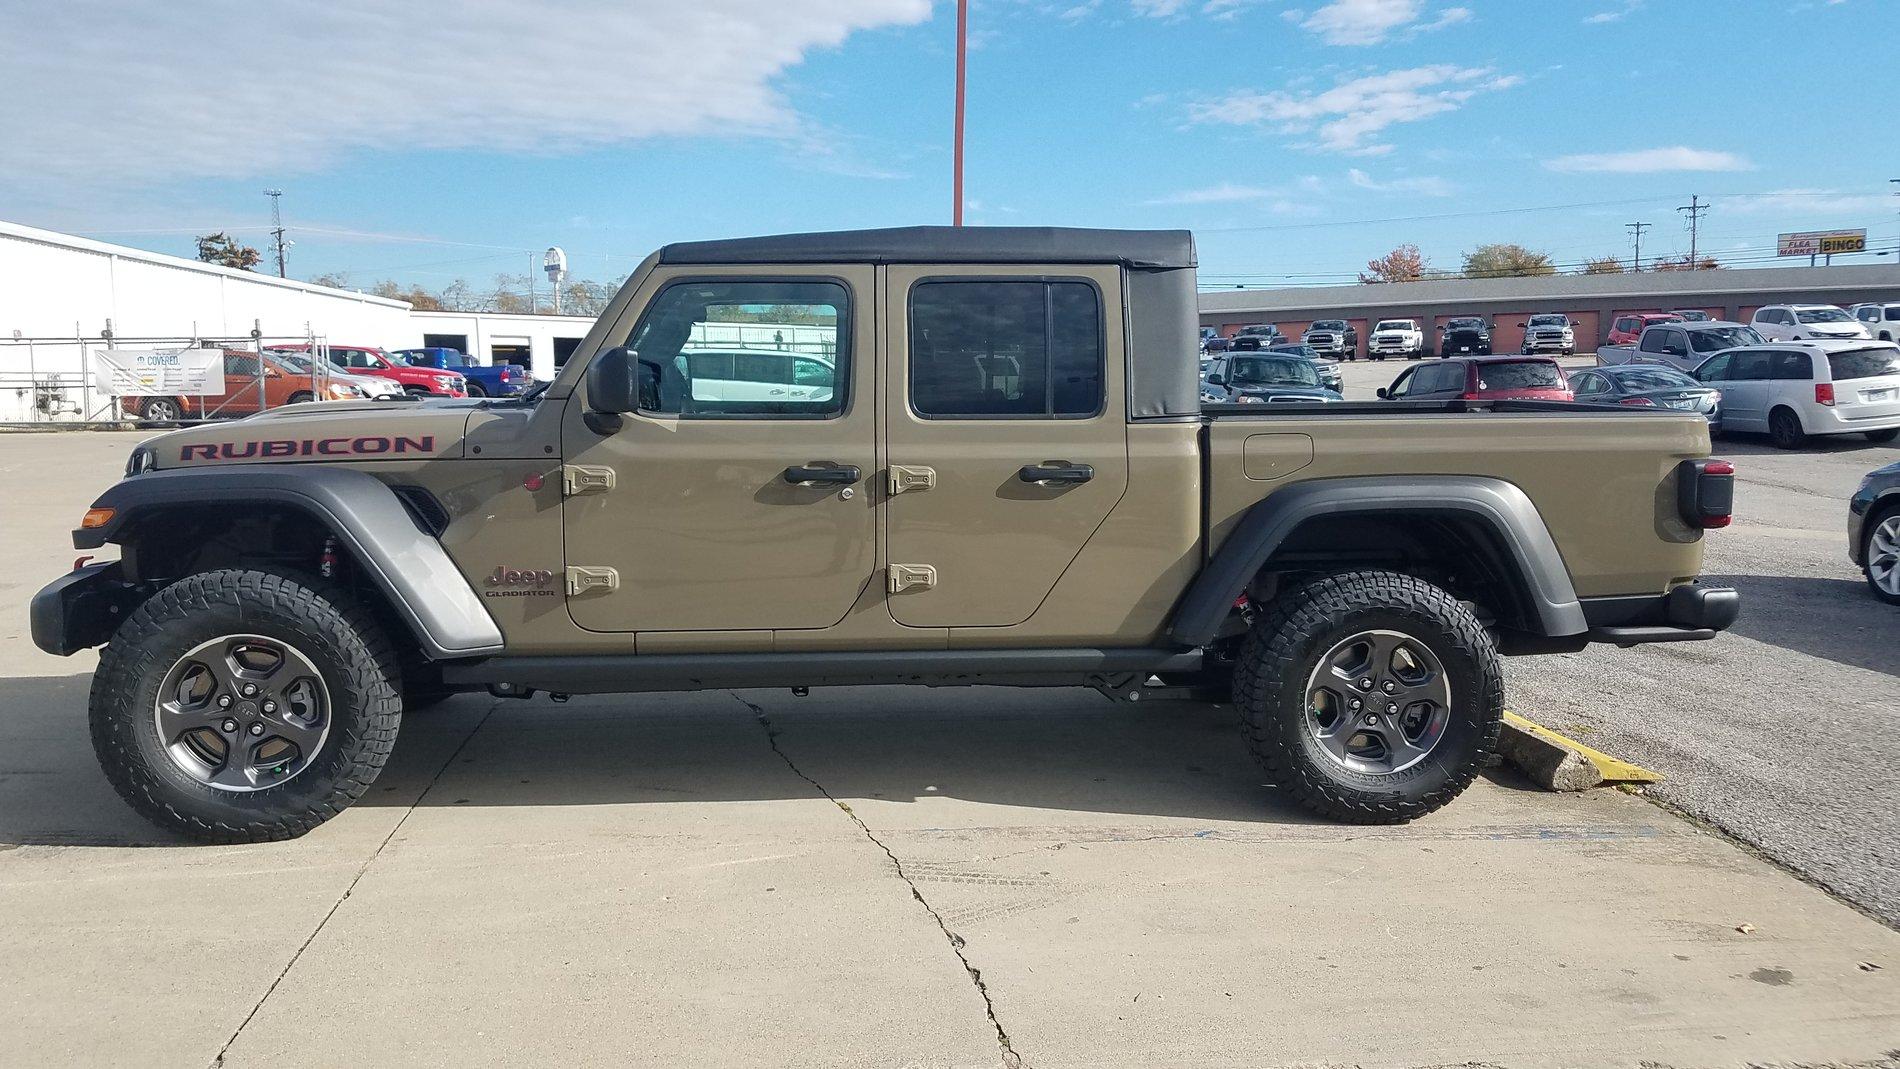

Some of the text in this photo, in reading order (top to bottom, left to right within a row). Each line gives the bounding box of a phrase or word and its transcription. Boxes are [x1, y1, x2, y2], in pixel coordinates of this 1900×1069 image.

[1788, 241, 1811, 249] FLEA
[1823, 239, 1865, 252] BINGO
[180, 436, 435, 461] RUBICON
[486, 565, 552, 588] Jeep
[485, 590, 555, 598] GLADIATOR
